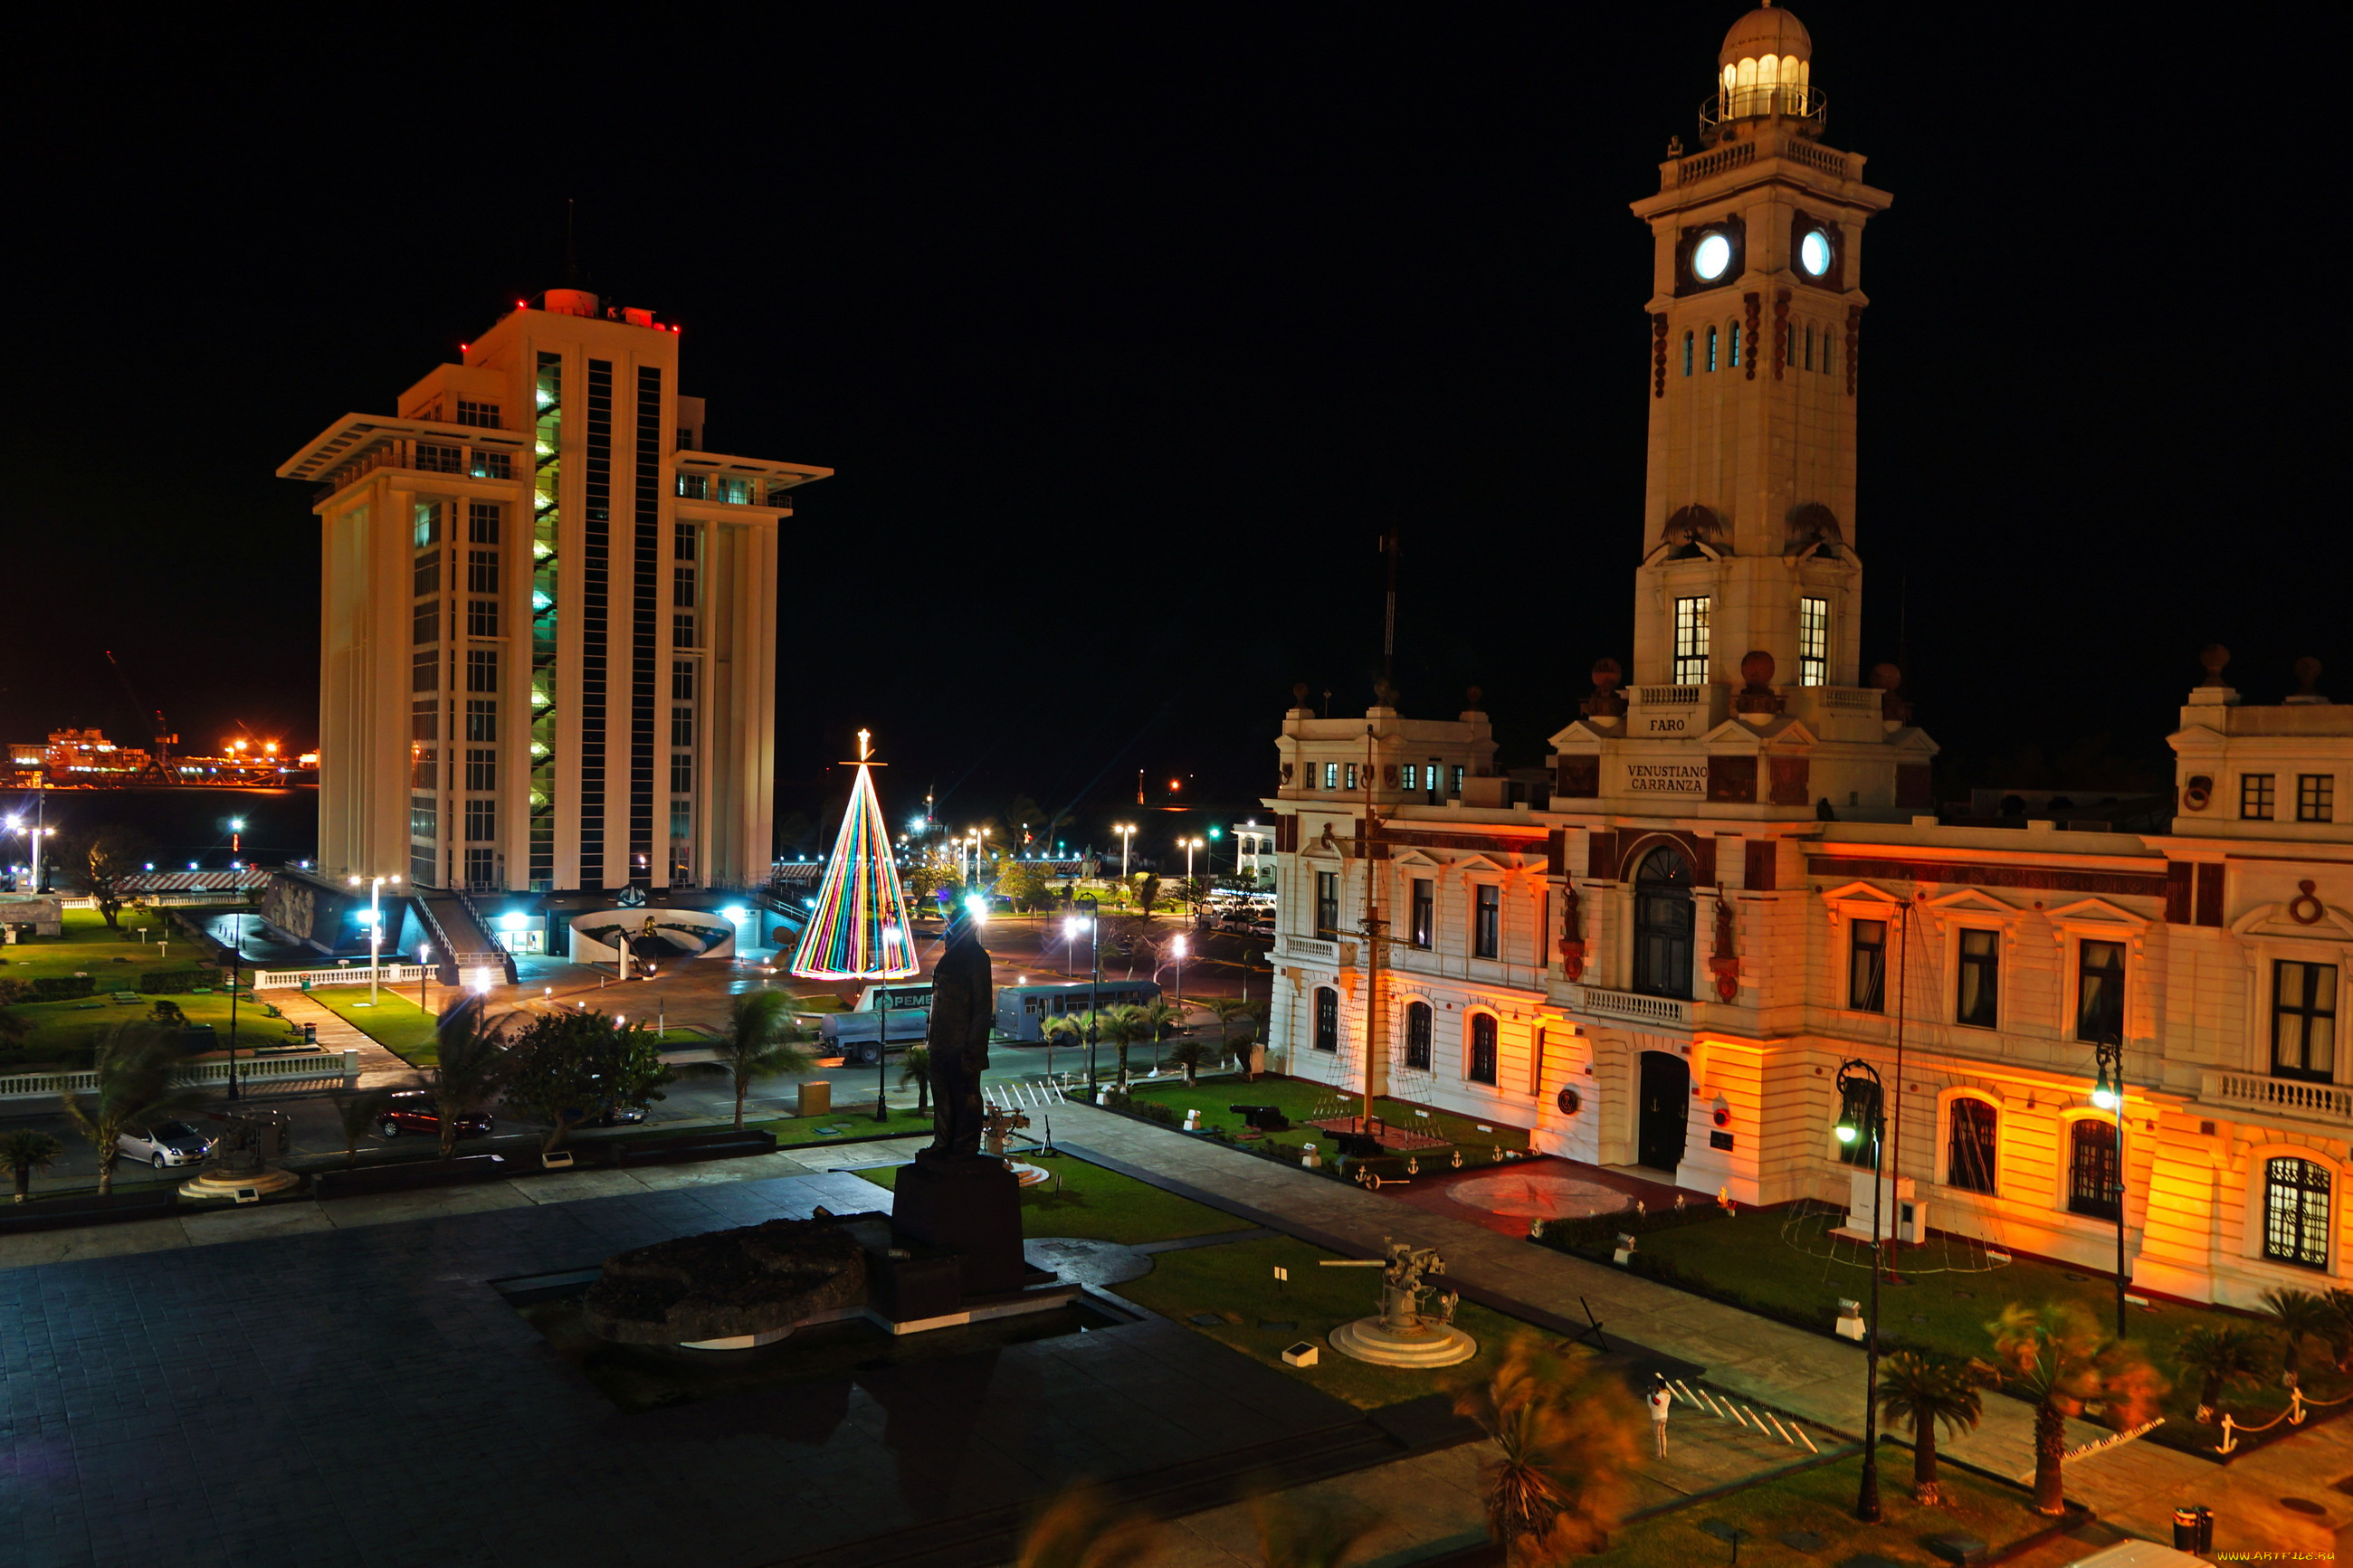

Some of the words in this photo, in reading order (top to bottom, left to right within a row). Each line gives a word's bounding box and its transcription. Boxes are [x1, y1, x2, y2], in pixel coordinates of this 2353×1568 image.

[1650, 719, 1685, 731] FARO
[1627, 765, 1708, 778] VENUSTIANO
[1631, 778, 1702, 792] CARRANZA
[894, 994, 932, 1007] PEME
